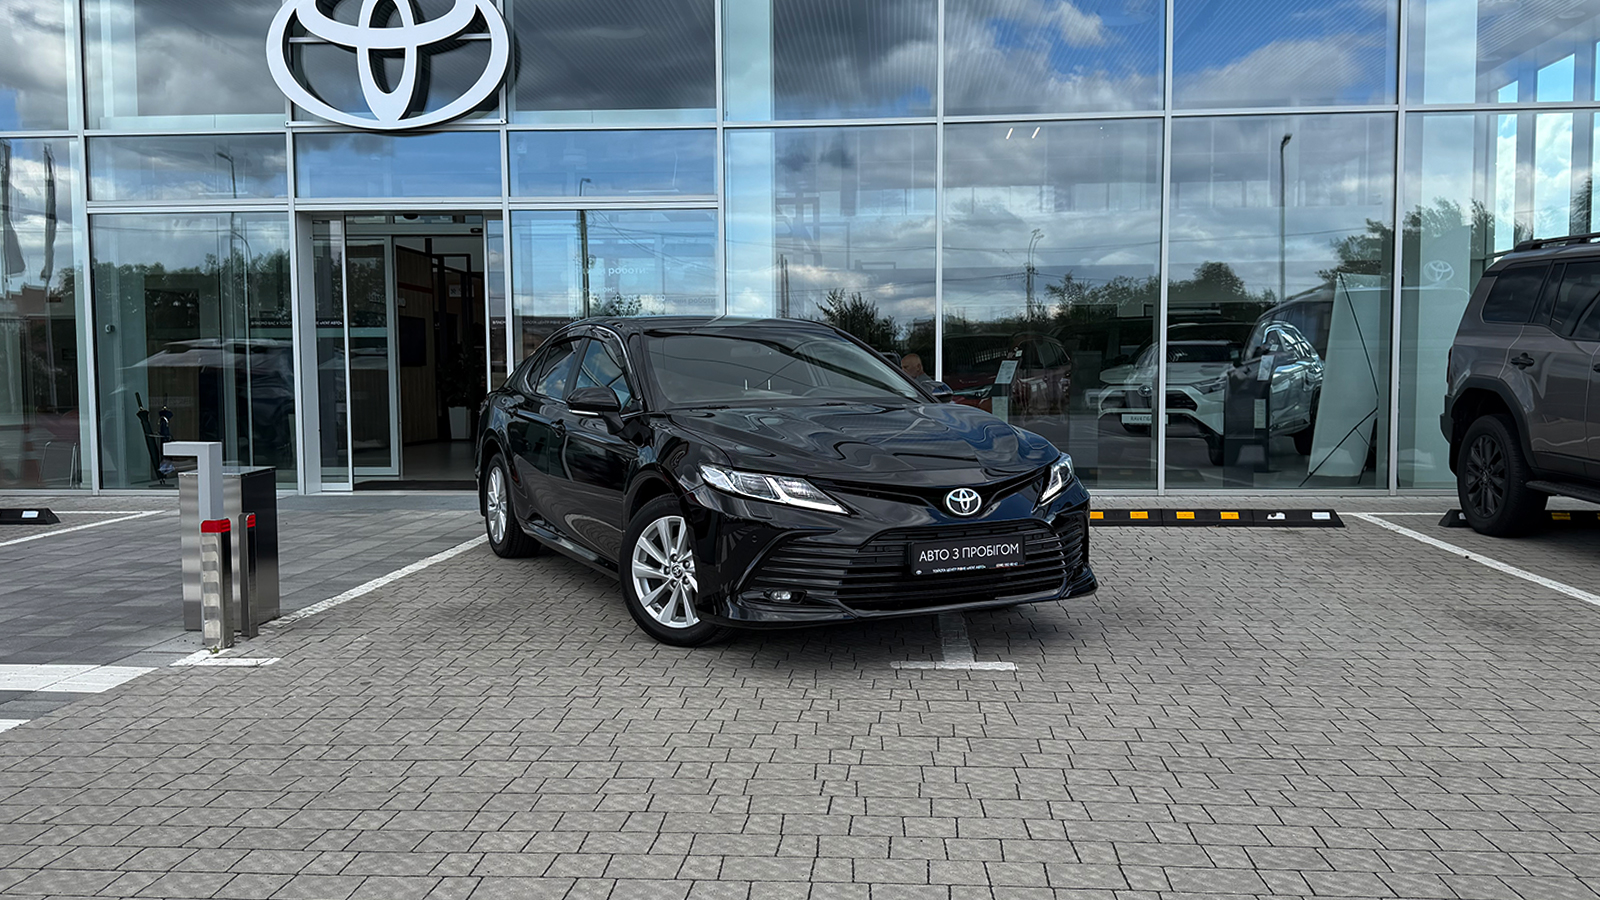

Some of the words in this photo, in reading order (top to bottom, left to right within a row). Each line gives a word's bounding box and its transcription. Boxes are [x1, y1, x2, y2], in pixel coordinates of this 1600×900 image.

[918, 548, 950, 562] АВТО
[952, 547, 960, 560] З
[962, 543, 1019, 559] ПРОБІГОМ
